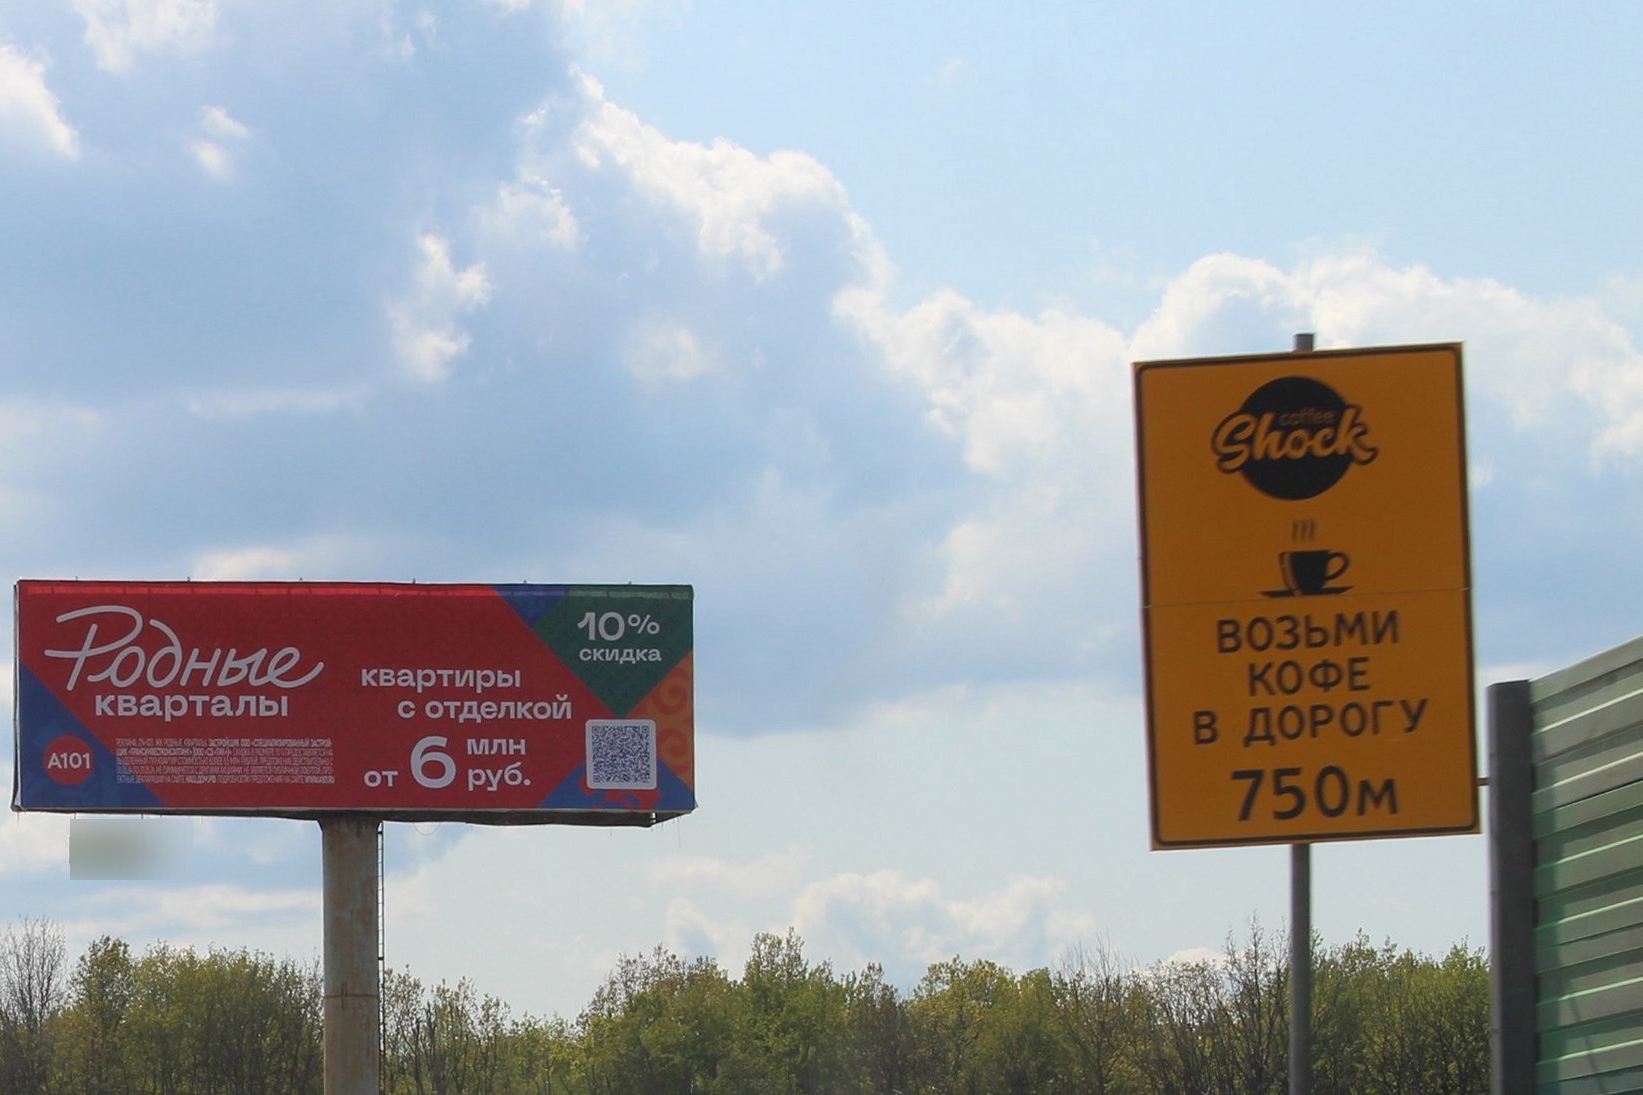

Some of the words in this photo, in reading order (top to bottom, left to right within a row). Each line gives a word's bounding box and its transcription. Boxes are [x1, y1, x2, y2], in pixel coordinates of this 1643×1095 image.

[1279, 408, 1336, 426] coffee
[1212, 404, 1379, 474] Shock
[577, 612, 660, 641] 10%
[1216, 610, 1399, 653] ВОЗЬМИ
[44, 605, 324, 691] Родные
[579, 648, 662, 664] скидка
[361, 669, 521, 693] квартиры
[1248, 657, 1371, 697] КОФЕ
[95, 695, 288, 722] кварталы
[398, 700, 415, 719] с
[425, 694, 571, 723] отделкой
[1193, 711, 1219, 745] В
[1243, 698, 1428, 747] ДОРОГУ
[364, 771, 398, 787] от
[410, 736, 456, 788] 6
[467, 739, 526, 755] млн
[468, 762, 531, 791] руб.
[1231, 765, 1400, 822] 750м
